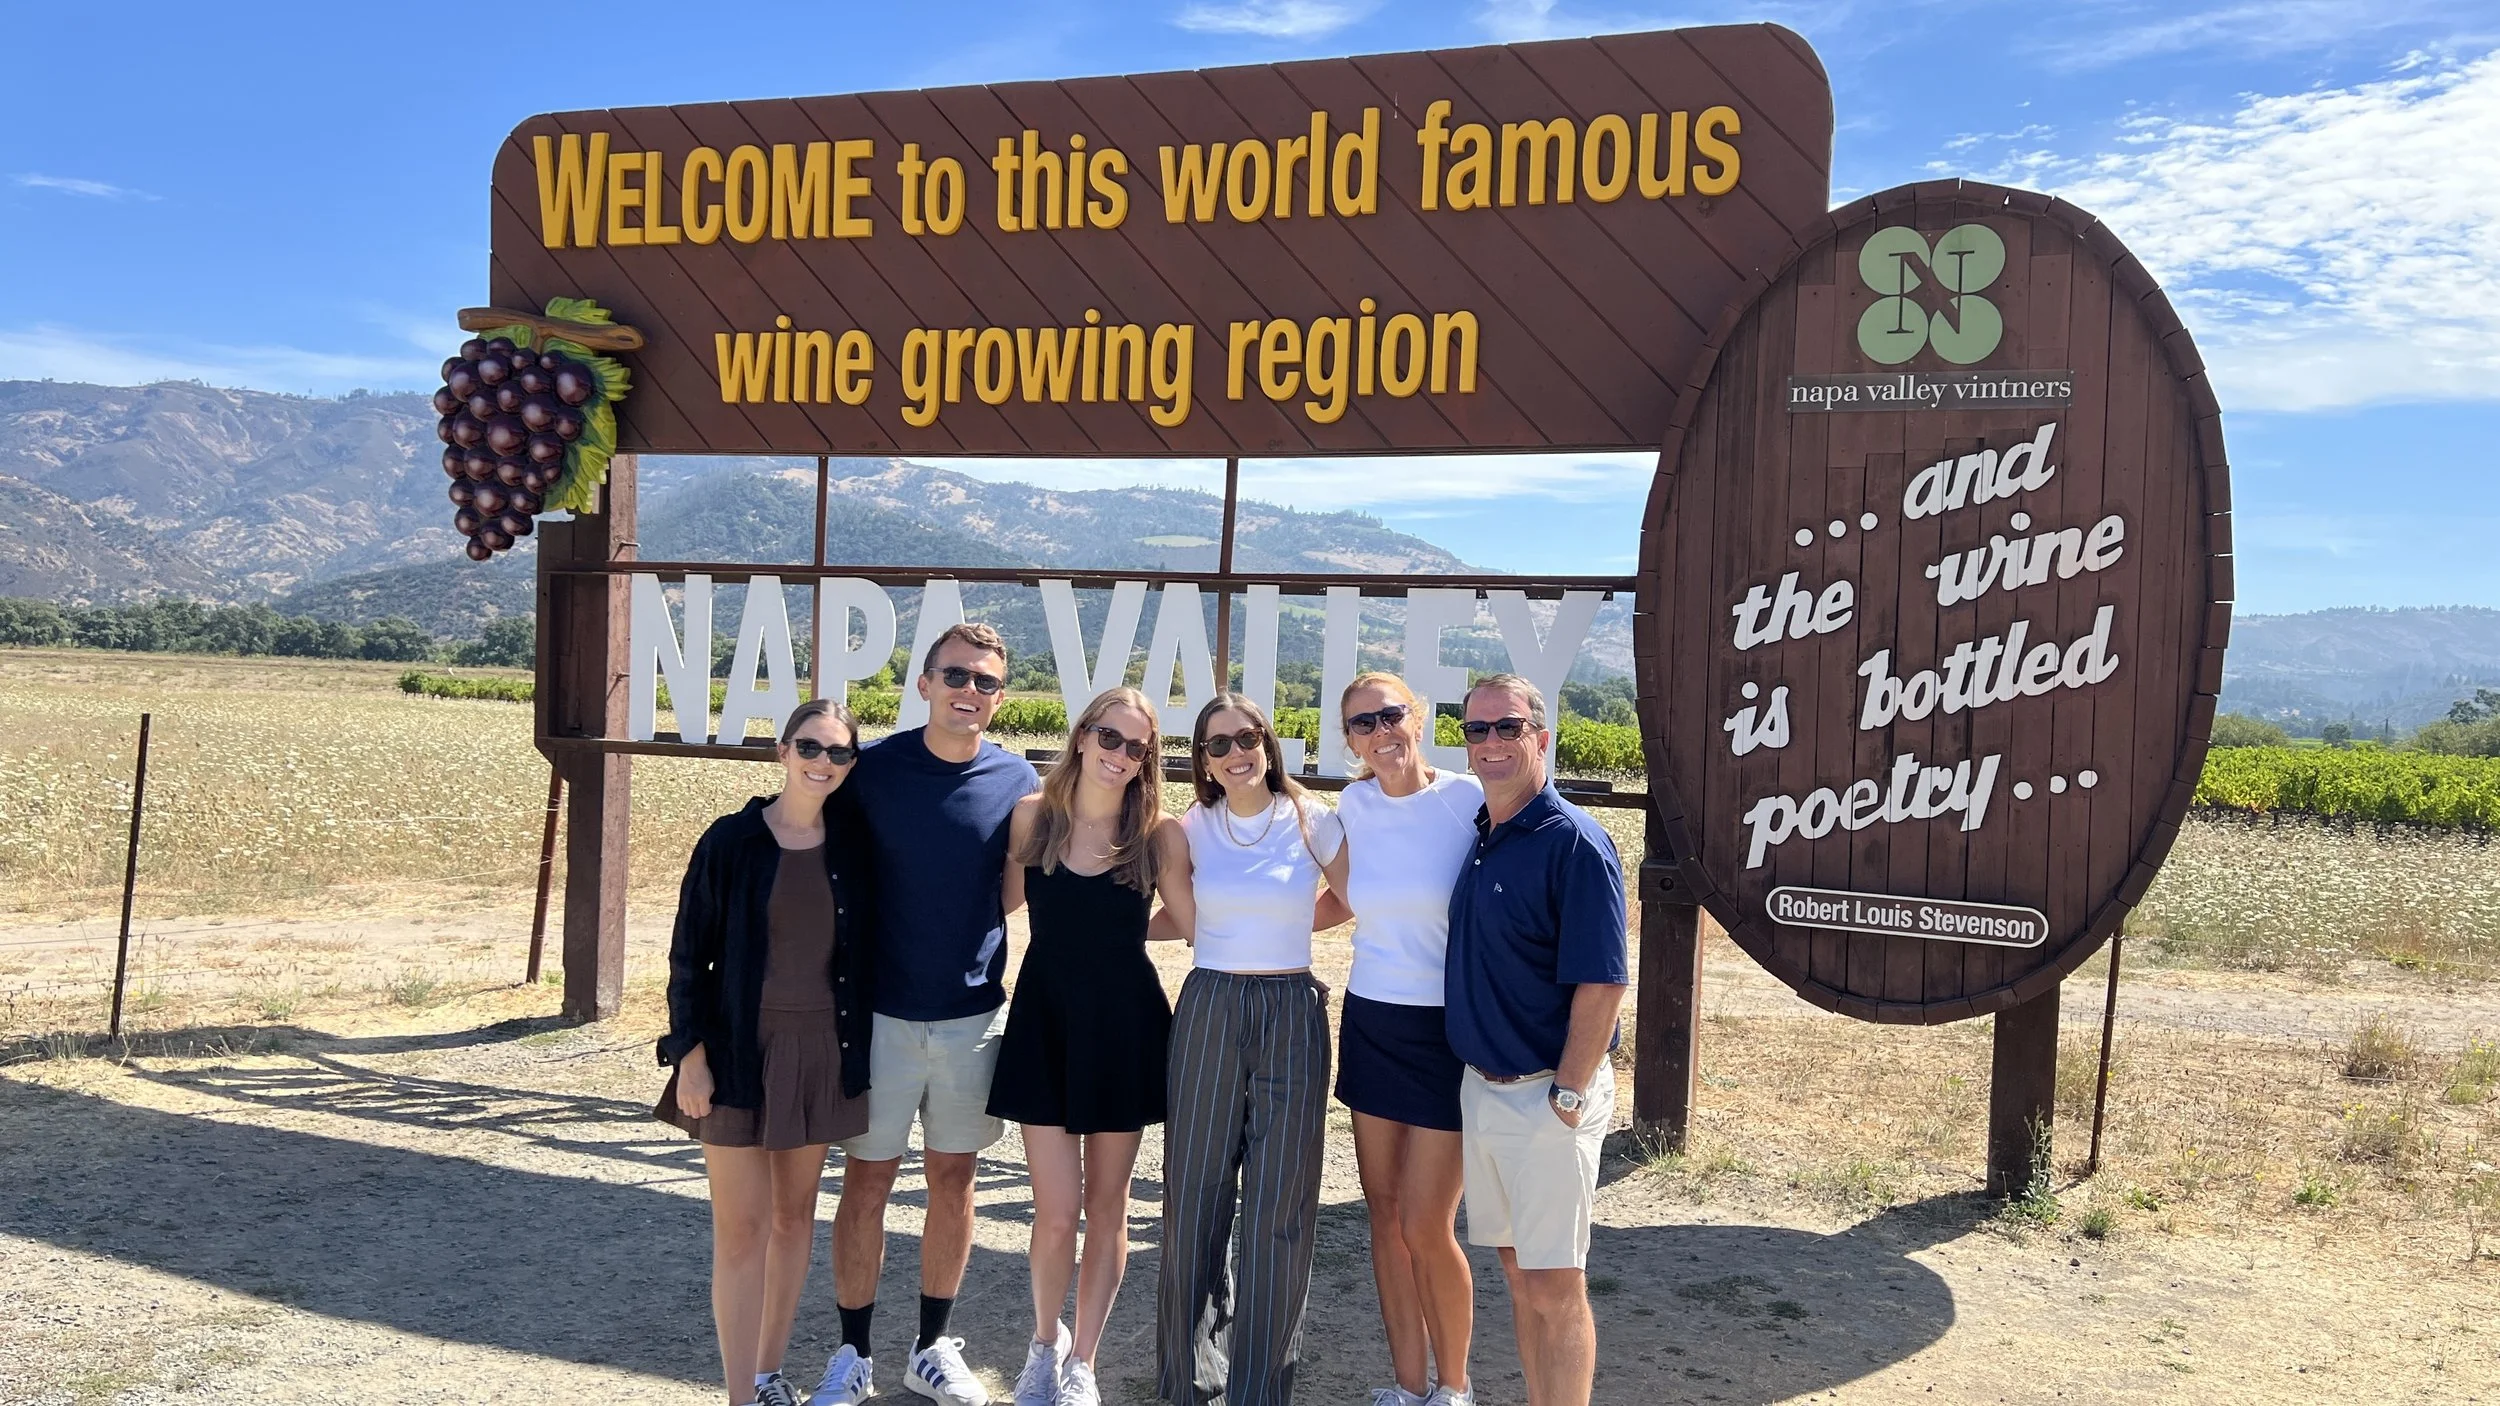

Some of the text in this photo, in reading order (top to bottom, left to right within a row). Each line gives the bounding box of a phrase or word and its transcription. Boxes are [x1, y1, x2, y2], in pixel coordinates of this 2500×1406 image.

[533, 100, 1741, 248] WELCOME to this world famous
[715, 297, 1479, 427] wine growing region
[1791, 375, 2072, 411] napa valley vintners
[1732, 512, 2125, 651] the wine
[1038, 579, 1607, 777] VALLEY
[1723, 605, 2119, 756] is bottled
[1778, 894, 2035, 940] Robert Louis Stevenson
